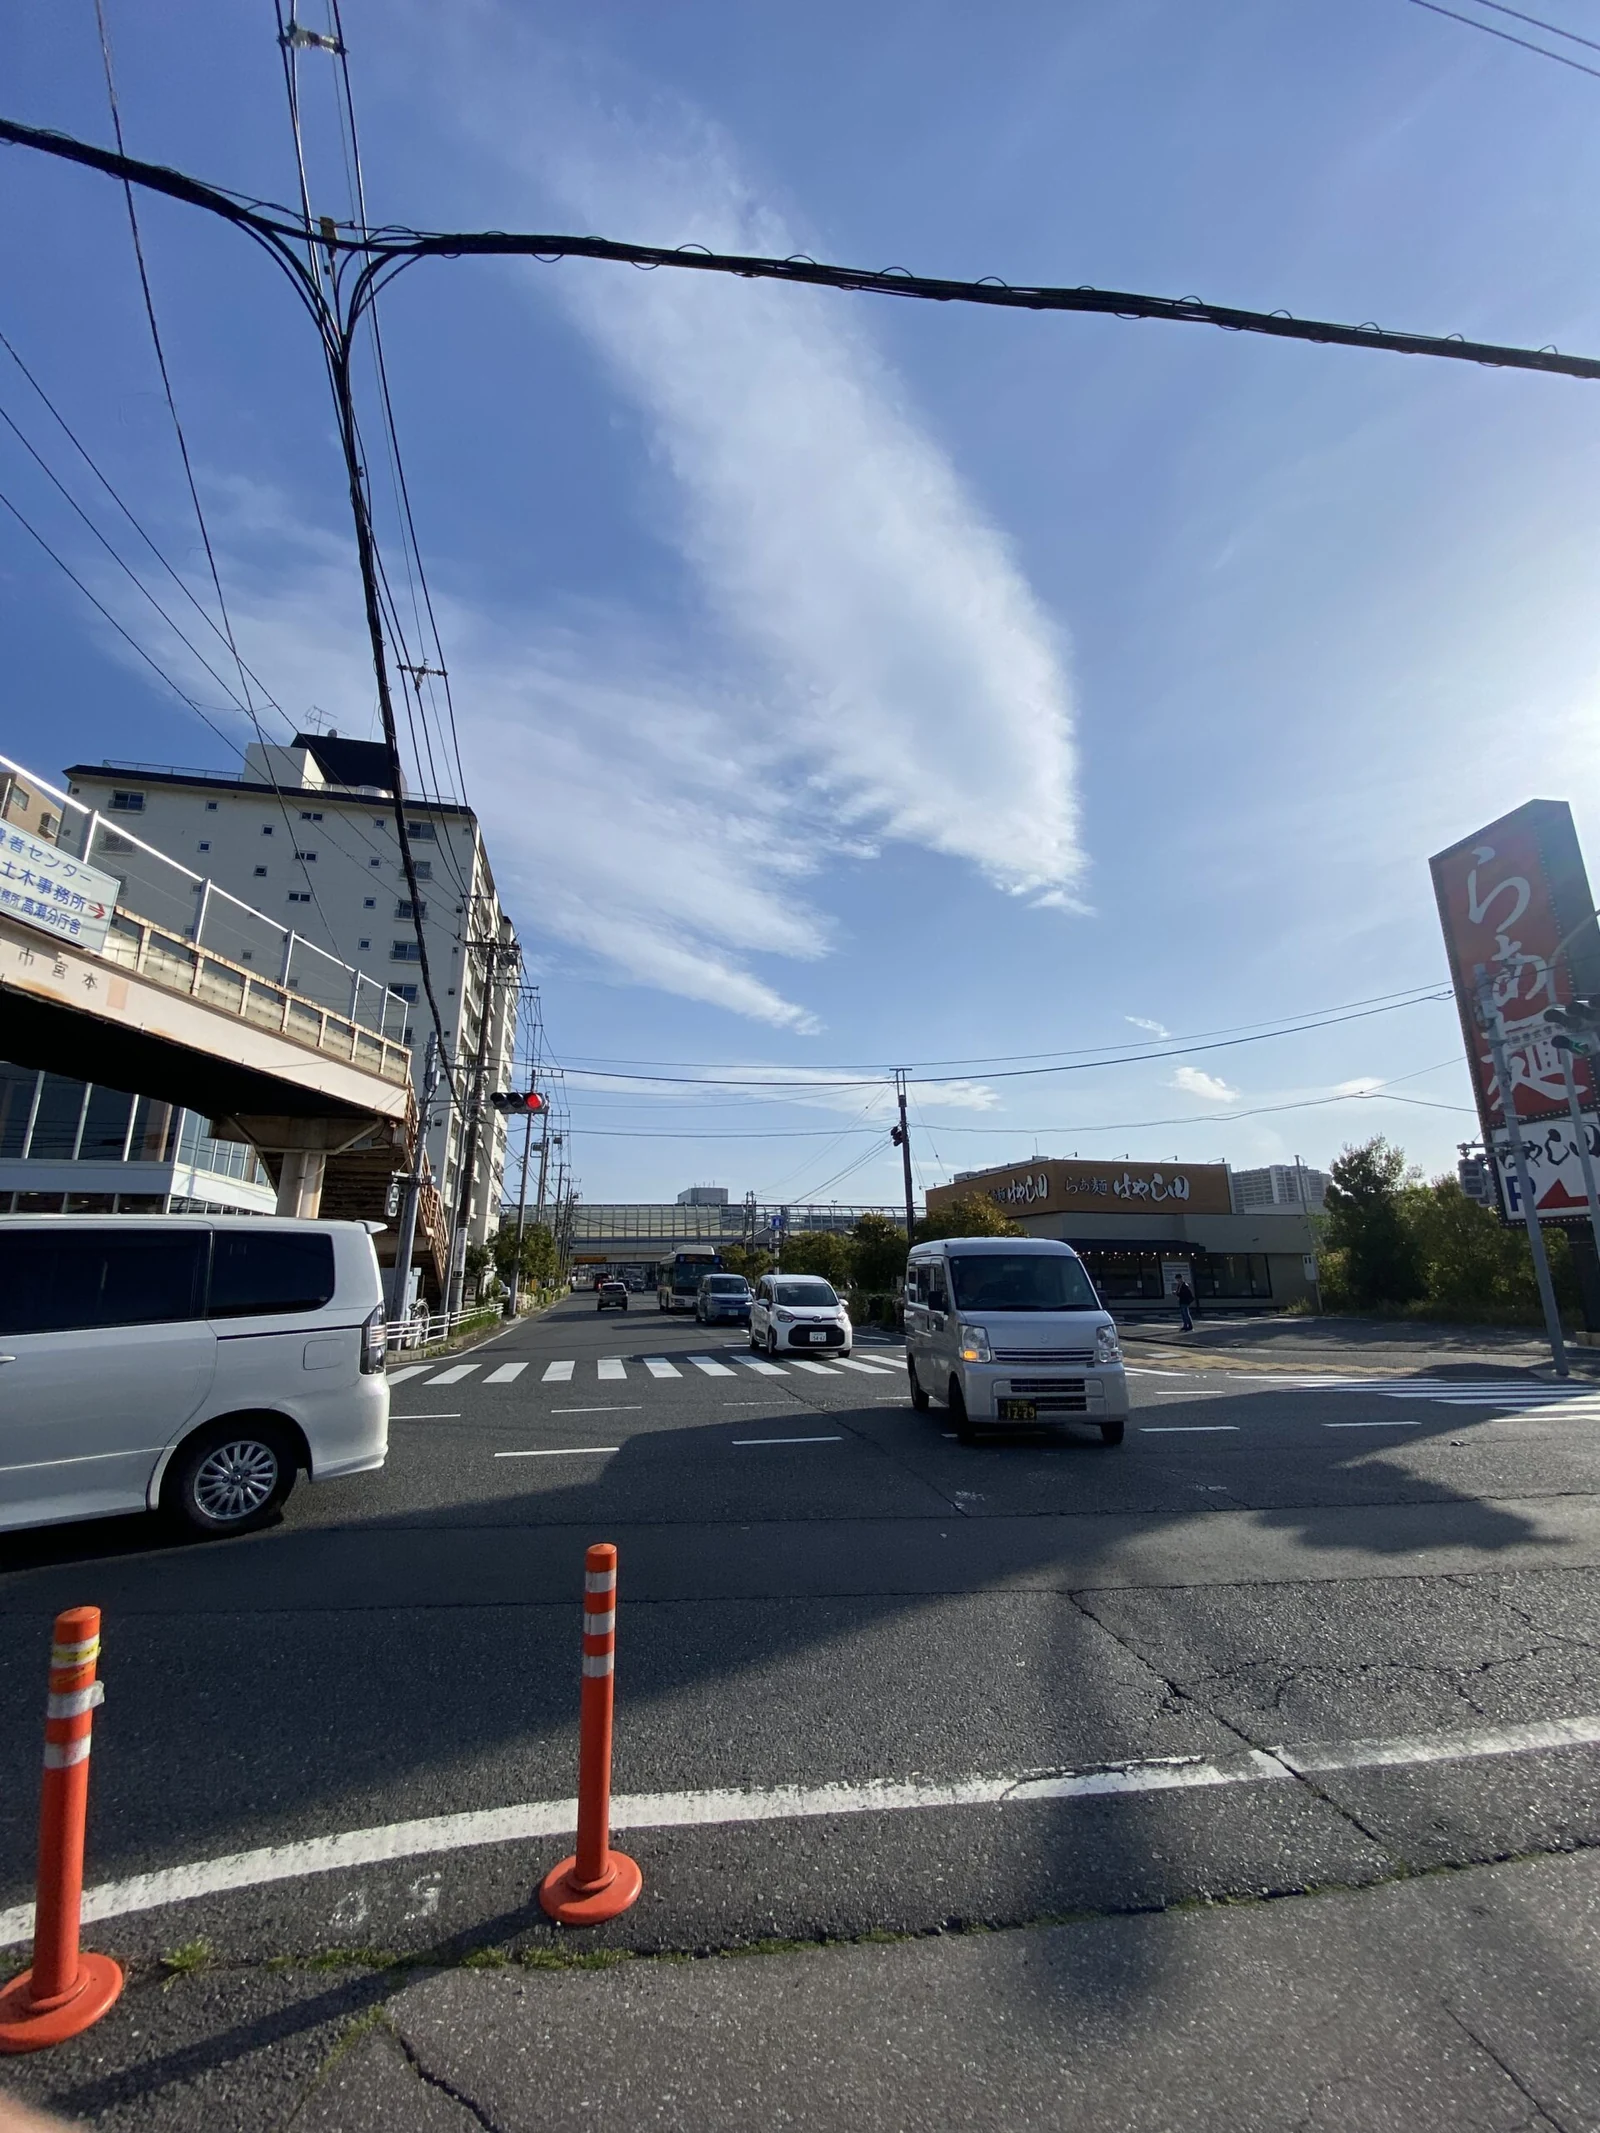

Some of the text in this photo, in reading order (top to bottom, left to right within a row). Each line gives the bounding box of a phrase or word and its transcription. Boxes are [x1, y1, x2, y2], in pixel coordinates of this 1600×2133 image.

[0, 861, 87, 912] 土木事務所
[1113, 1172, 1190, 1202] はやし田
